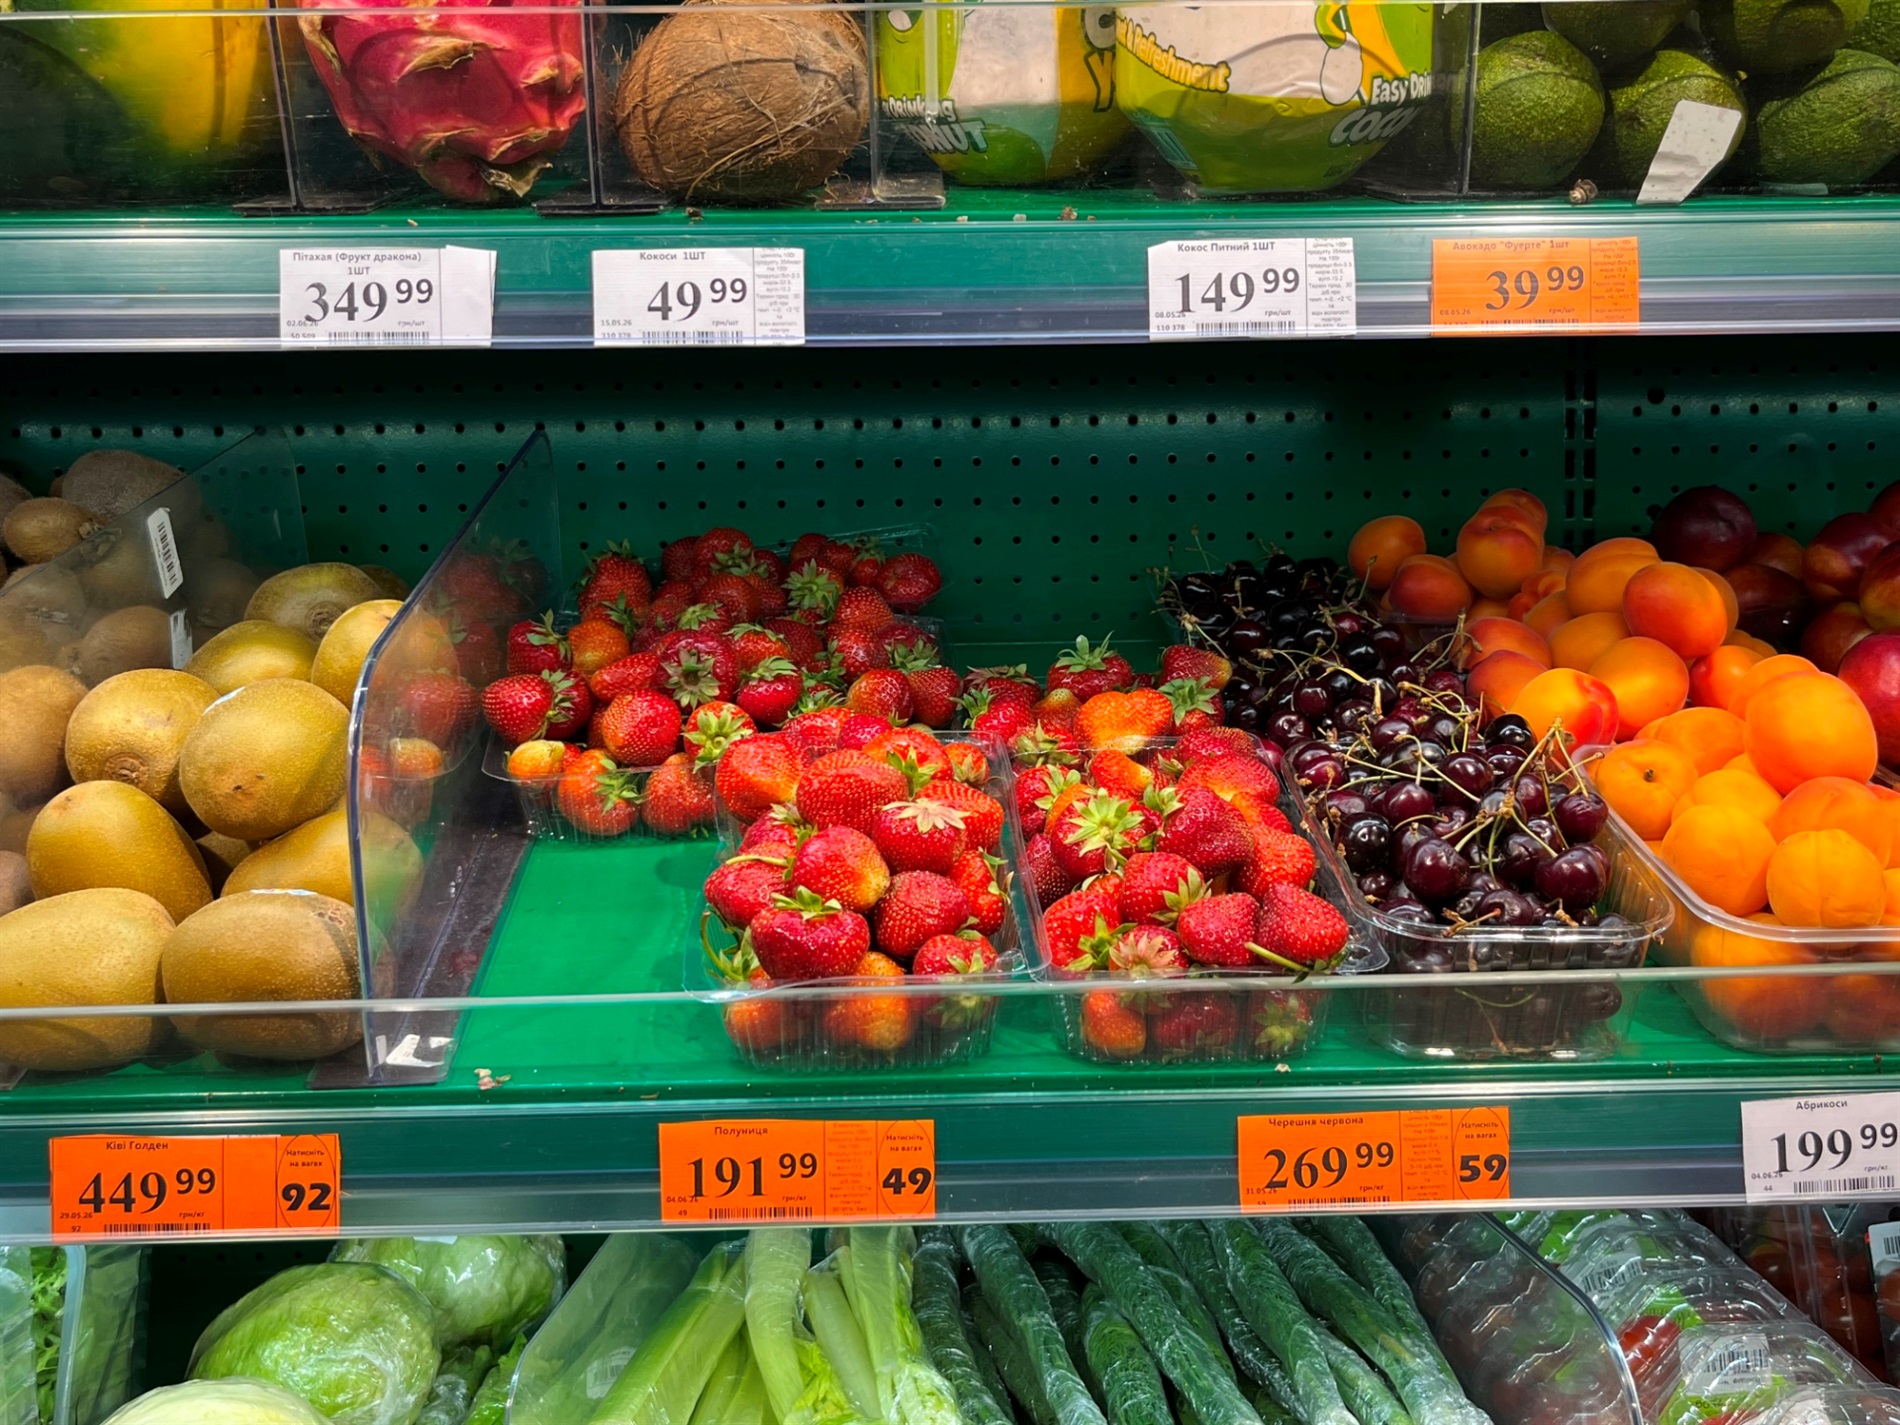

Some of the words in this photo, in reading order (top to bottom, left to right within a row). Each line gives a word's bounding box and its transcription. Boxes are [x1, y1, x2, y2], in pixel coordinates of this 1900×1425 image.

[1370, 76, 1409, 107] Easy
[293, 252, 332, 261] Пітахая
[335, 252, 372, 262] (Фрукт
[373, 252, 422, 262] дракона)
[639, 251, 678, 261] Кокоси
[683, 251, 706, 260] 1ШТ
[1177, 243, 1208, 252] Кокос
[1210, 242, 1249, 251] Питний
[1252, 241, 1275, 250] 1ШТ
[1453, 242, 1497, 251] Авокадо
[1500, 240, 1545, 251] "Фуерте"
[1550, 240, 1570, 249] 1шт
[347, 266, 371, 275] 1ШТ
[304, 281, 388, 323] 349
[395, 278, 434, 304] 99
[647, 281, 702, 323] 49
[710, 278, 747, 303] 99
[1175, 272, 1255, 313] 149
[1262, 267, 1300, 294] 99
[1485, 270, 1539, 311] 39
[1547, 265, 1584, 291] 99
[600, 319, 632, 327] 15.05.26
[1796, 1100, 1848, 1111] Абрикоси
[715, 1127, 768, 1137] Полуниця
[1269, 1118, 1317, 1129] Черешня
[1320, 1117, 1364, 1127] червона
[106, 1141, 126, 1150] Ківі
[129, 1140, 169, 1150] Голден
[1770, 1129, 1852, 1173] 199
[1860, 1122, 1898, 1149] 99
[688, 1156, 768, 1198] 191
[779, 1152, 818, 1179] 99
[1264, 1146, 1348, 1189] 269
[1355, 1142, 1394, 1168] 99
[1459, 1154, 1507, 1183] 59
[79, 1172, 167, 1214] 449
[176, 1168, 216, 1195] 99
[882, 1167, 932, 1195] 49
[281, 1183, 332, 1211] 92
[60, 1212, 93, 1220] 29.05.26
